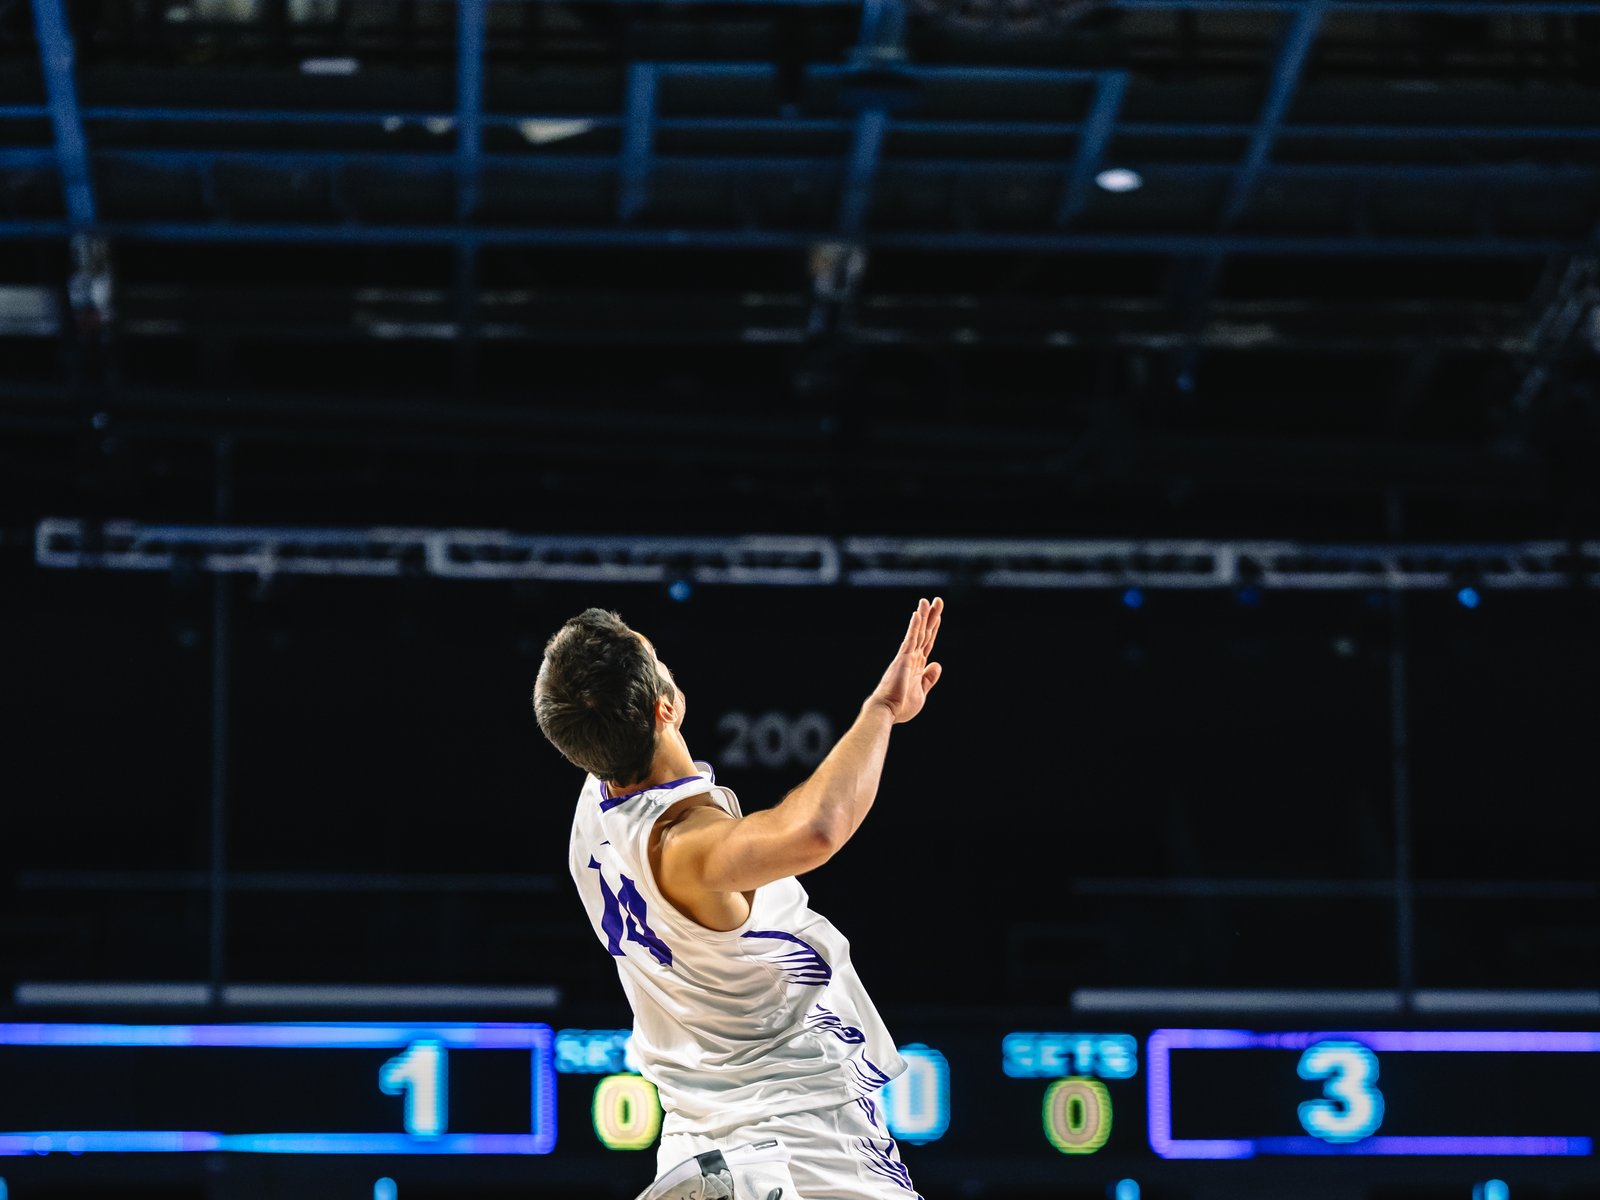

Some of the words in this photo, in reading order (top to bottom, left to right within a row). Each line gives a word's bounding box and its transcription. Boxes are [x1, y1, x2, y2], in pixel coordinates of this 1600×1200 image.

[717, 713, 833, 767] 200
[588, 853, 673, 967] 14
[380, 1039, 447, 1138] 1
[592, 1073, 661, 1150] 0
[1042, 1078, 1112, 1154] 0
[1299, 1040, 1384, 1142] 3
